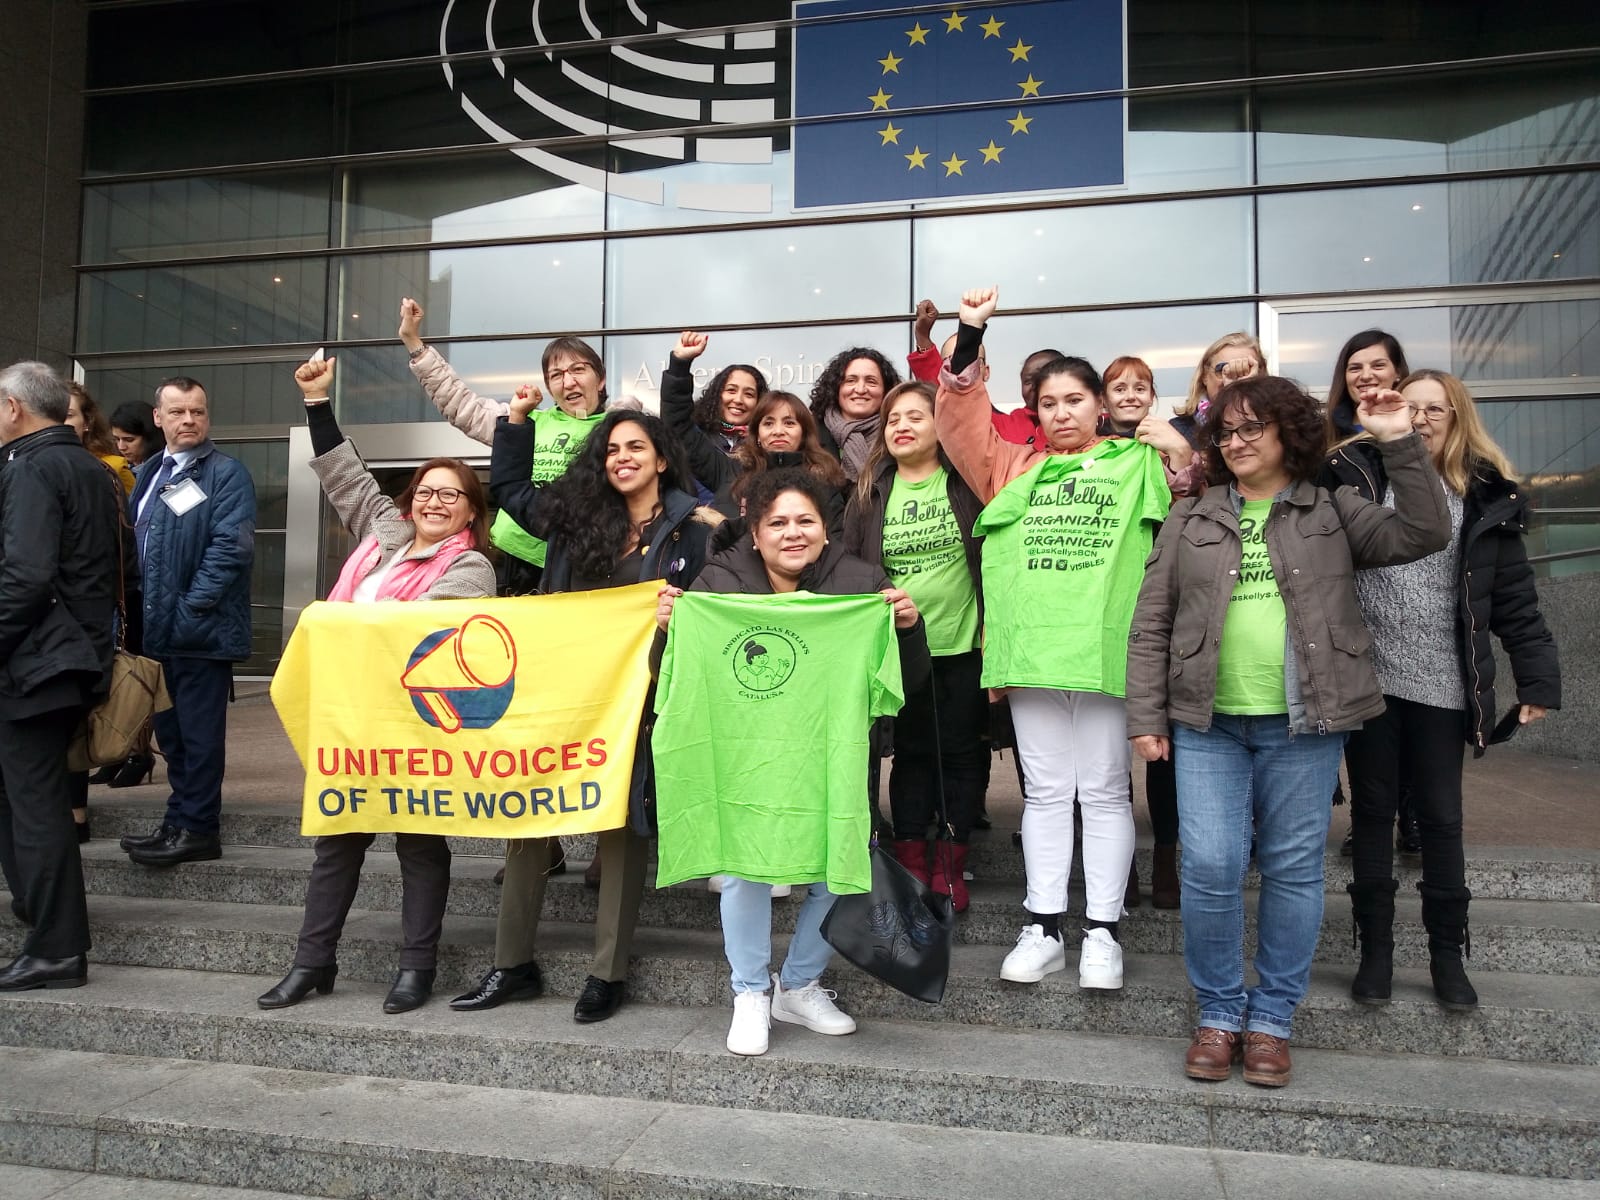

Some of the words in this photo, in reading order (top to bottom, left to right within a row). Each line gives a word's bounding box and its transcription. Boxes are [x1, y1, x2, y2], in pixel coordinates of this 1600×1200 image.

[1029, 490, 1056, 507] las
[883, 517, 902, 526] as
[1023, 515, 1120, 529] ORGANIZATE
[883, 521, 959, 541] RGANIZAT
[1024, 536, 1114, 548] ORGANICEN
[1028, 548, 1098, 558] @LasKellysBCN
[924, 554, 957, 572] VISIBLES
[1070, 558, 1105, 571] VISIBLES
[1230, 591, 1281, 603] askellys.o
[722, 626, 762, 656] SINDICATO
[766, 625, 783, 633] LAS
[784, 629, 810, 655] KELLYS
[317, 747, 452, 777] UNITED
[463, 738, 607, 778] VOICES
[318, 788, 367, 817] OF
[381, 788, 454, 817] THE
[463, 781, 601, 819] WORLD
